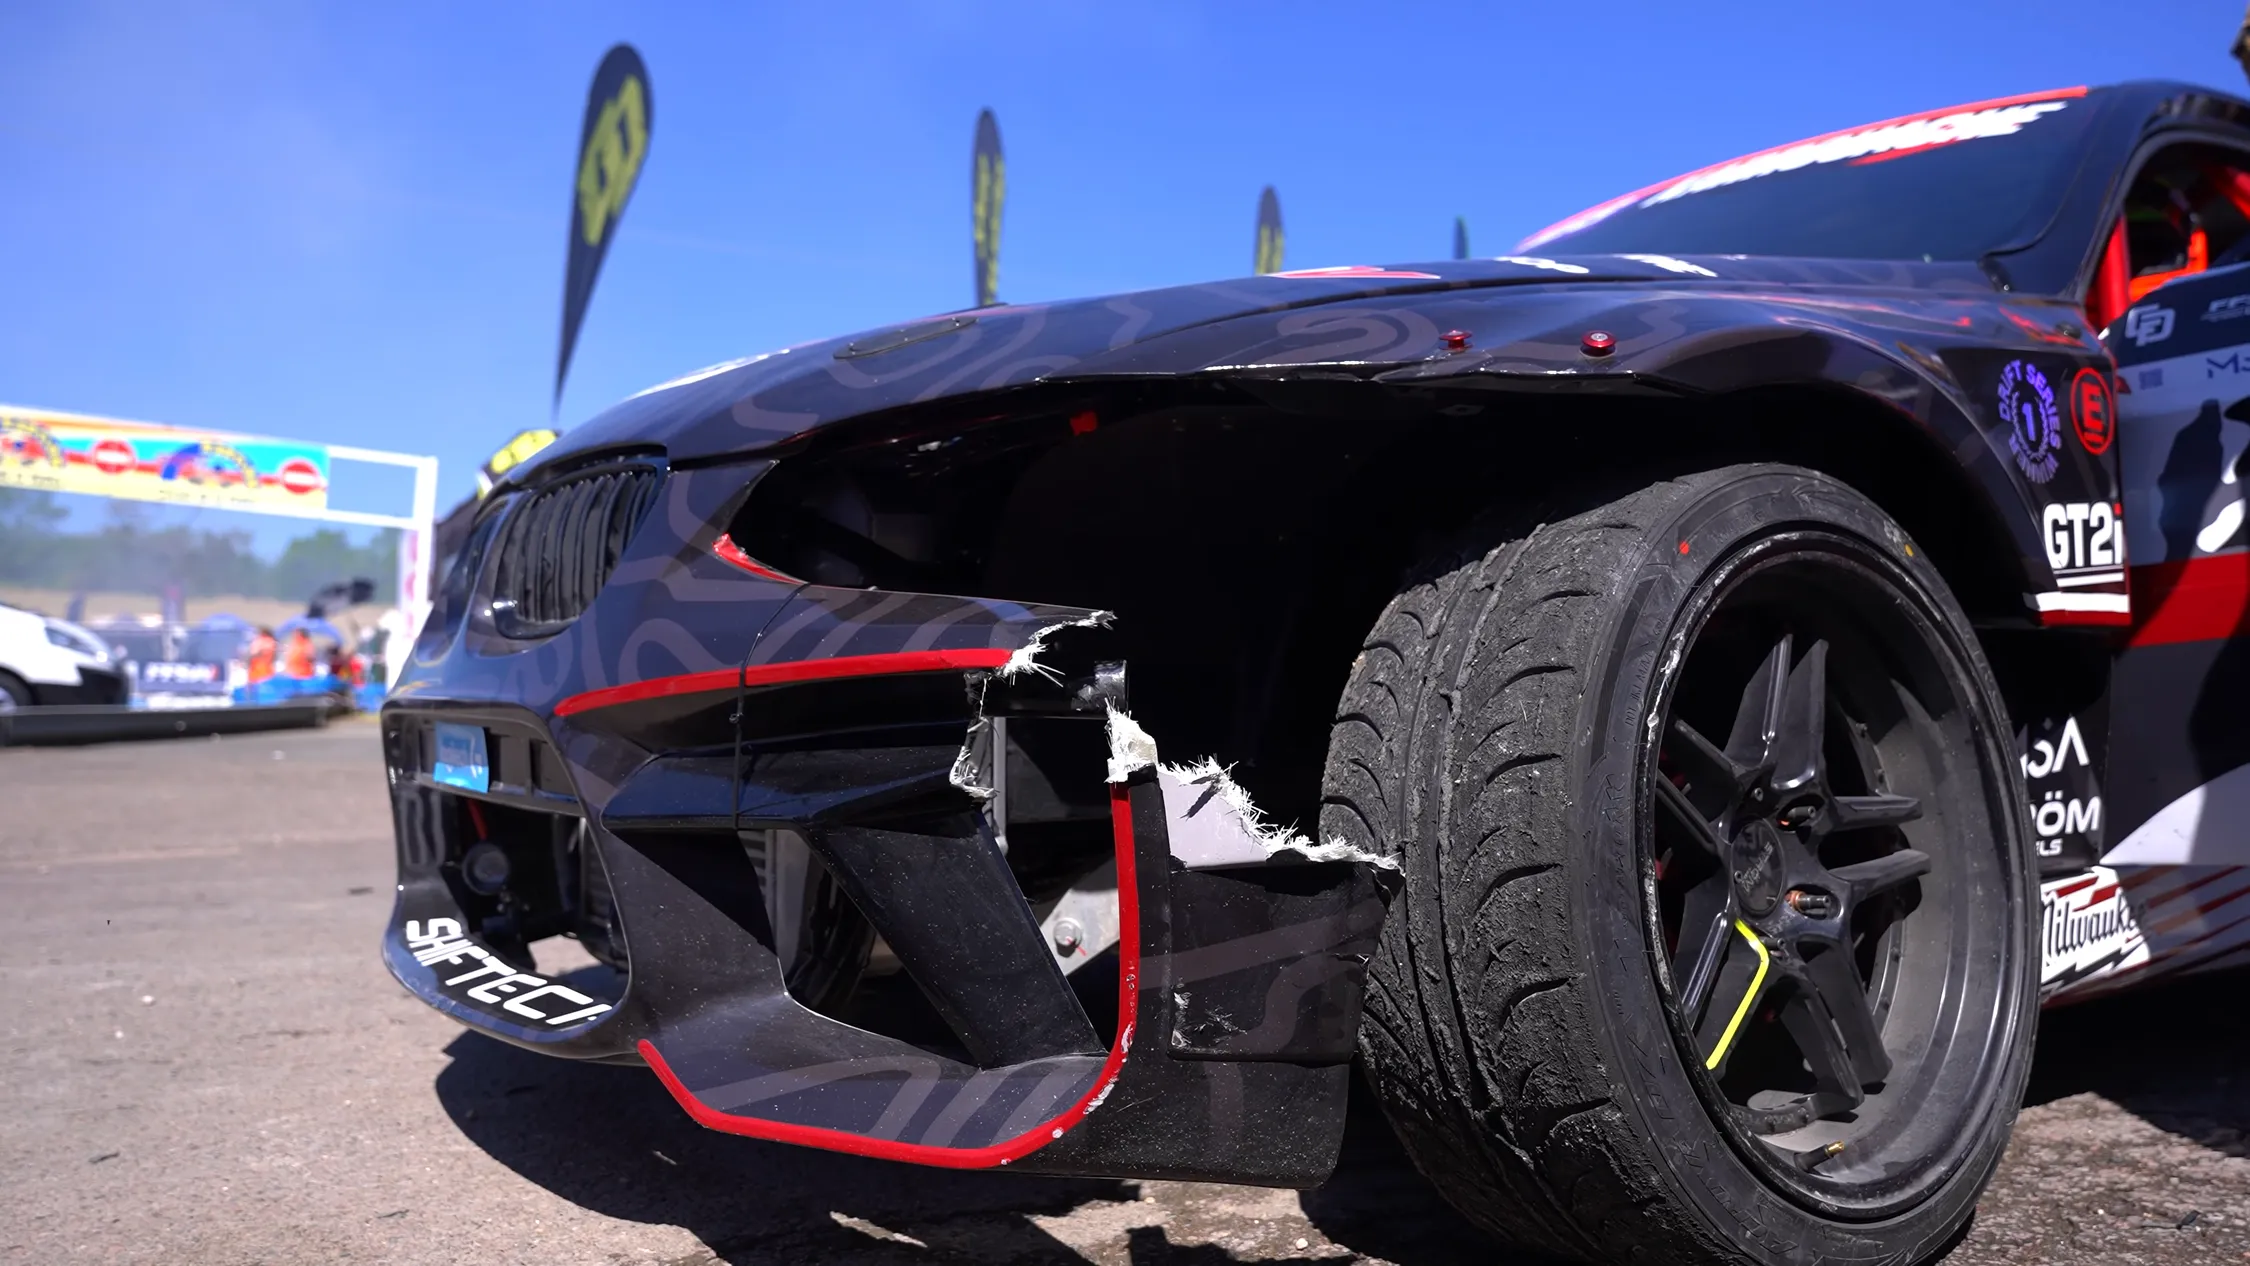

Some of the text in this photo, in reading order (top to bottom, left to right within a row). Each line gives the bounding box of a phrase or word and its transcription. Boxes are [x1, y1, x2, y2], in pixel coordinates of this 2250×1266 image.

[2021, 401, 2036, 441] 1
[2026, 363, 2061, 449] SERIES
[2044, 501, 2124, 569] GT2i
[2029, 790, 2101, 836] ÖM
